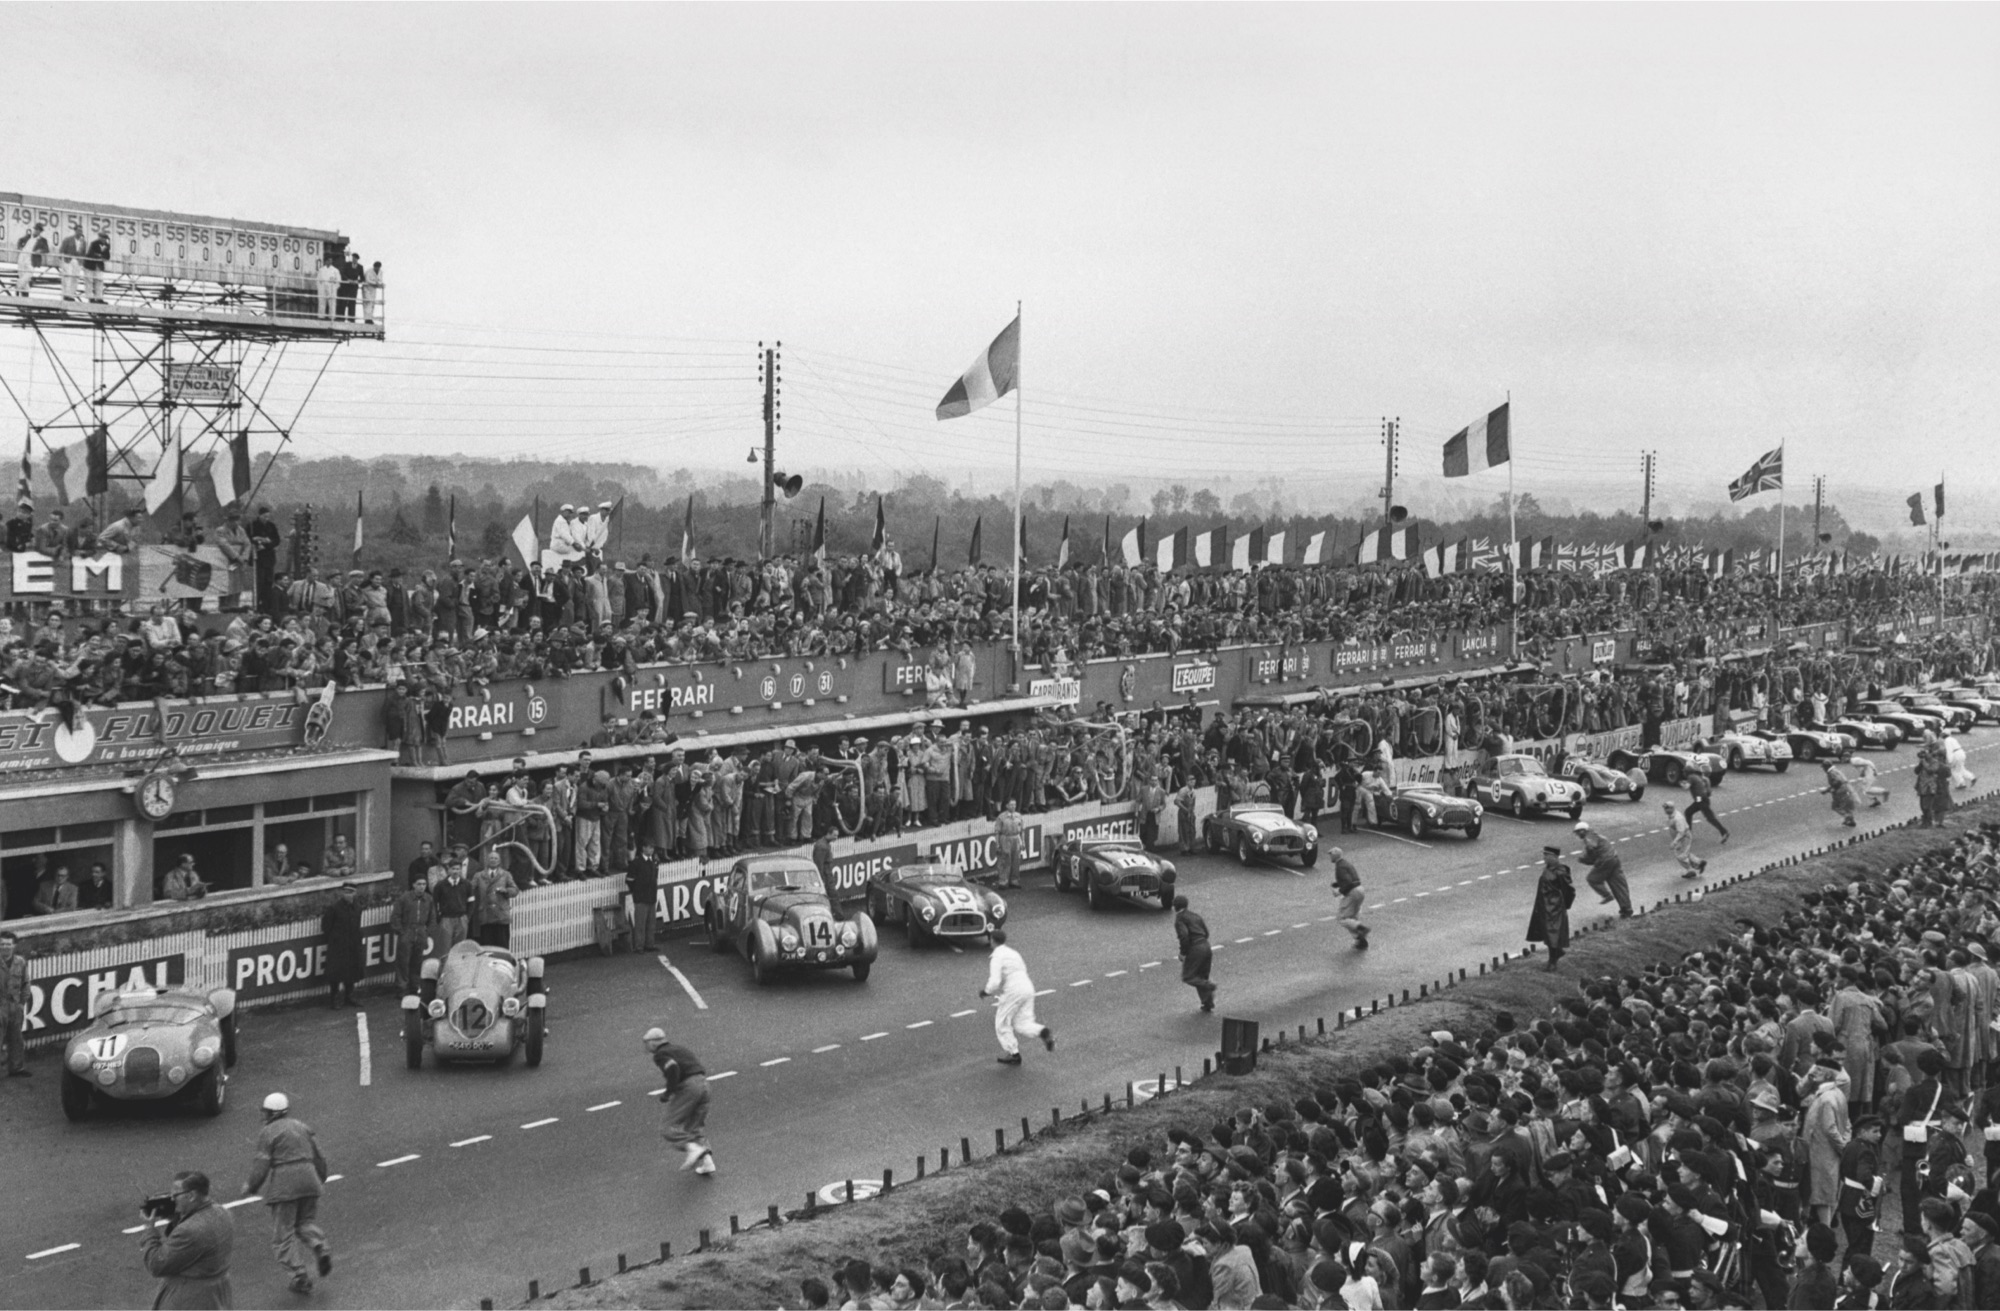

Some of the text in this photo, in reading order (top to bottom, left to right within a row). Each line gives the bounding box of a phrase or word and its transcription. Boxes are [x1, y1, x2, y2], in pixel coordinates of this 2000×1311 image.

[12, 208, 319, 255] 49 50 51 52 53 54 55 56 57 58 59 60 61
[1395, 644, 1427, 659] FERRARI
[1462, 636, 1487, 651] LANCIA
[1258, 657, 1297, 675] FERARI
[1336, 649, 1370, 666] FERRARI
[896, 662, 956, 686] FERRI
[764, 679, 774, 696] 16
[793, 677, 803, 694] 17
[821, 674, 831, 691] 31
[531, 701, 544, 719] 15
[1594, 730, 1638, 759] DUNLOP
[100, 748, 115, 760] la
[1548, 783, 1566, 795] 19
[939, 888, 971, 905] 15
[809, 922, 832, 946] 14
[460, 1004, 487, 1032] 12
